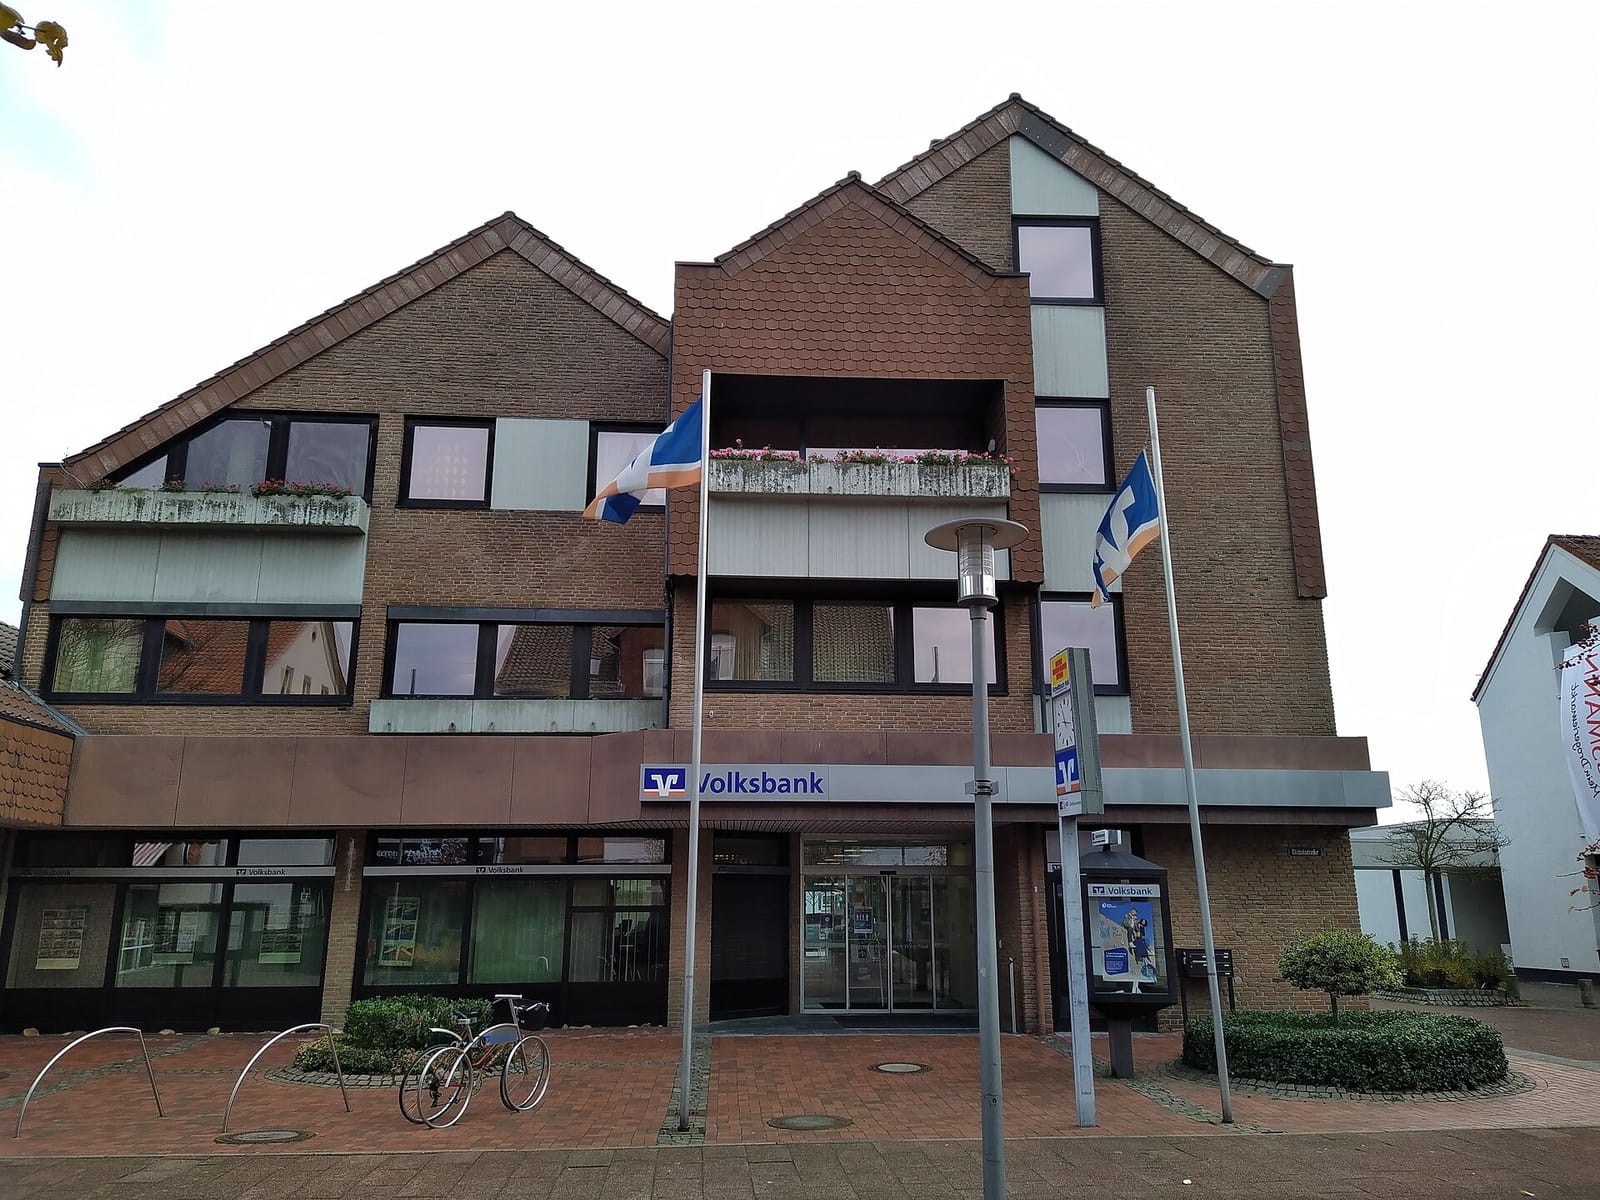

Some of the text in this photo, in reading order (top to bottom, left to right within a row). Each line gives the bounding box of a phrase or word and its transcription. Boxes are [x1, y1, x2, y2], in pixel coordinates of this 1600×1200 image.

[699, 771, 824, 793] Volksbank
[248, 868, 286, 876] Volksbank
[488, 866, 525, 874] Volksbank
[1108, 886, 1153, 896] Volksbank
